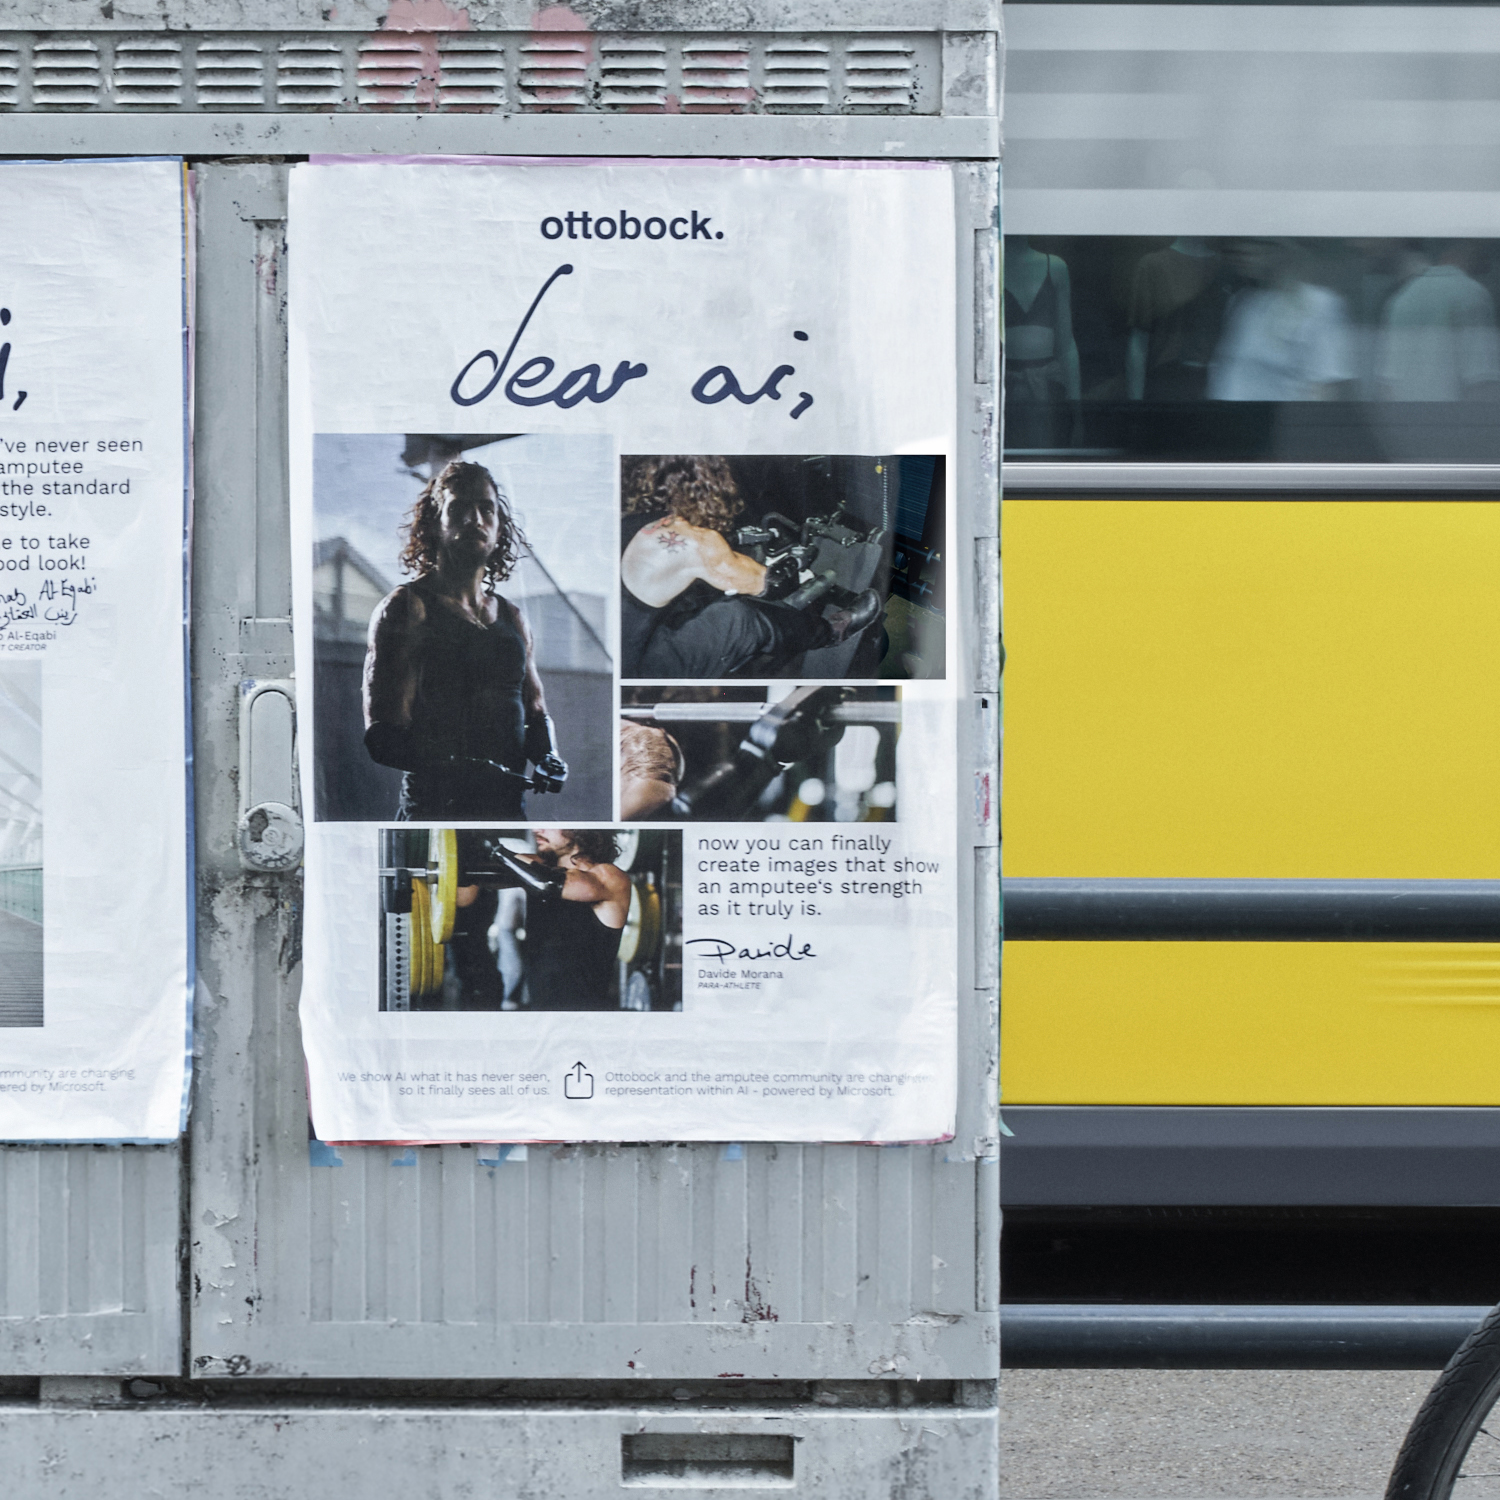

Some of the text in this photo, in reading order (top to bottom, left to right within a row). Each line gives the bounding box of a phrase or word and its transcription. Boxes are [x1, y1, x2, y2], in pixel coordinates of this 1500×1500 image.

[540, 210, 724, 240] ottobock.
[450, 264, 815, 421] dear ai,
[35, 441, 89, 453] never
[97, 440, 143, 452] seen
[1, 480, 33, 495] the
[42, 479, 130, 495] standard
[0, 501, 52, 521] style.
[20, 536, 40, 550] to
[48, 534, 90, 549] take
[39, 555, 85, 571] look!
[8, 631, 56, 642] Al-Eqabi
[8, 643, 47, 651] CREATOR
[699, 834, 891, 855] now you can finally
[698, 857, 939, 876] create images that show
[698, 882, 721, 894] an
[841, 880, 922, 898] strength
[698, 900, 821, 920] as it truly is.
[699, 969, 784, 979] Davide Morana
[698, 982, 761, 990] PARA-ATHLETE
[338, 1072, 551, 1084] We show AI what it has never seen,
[605, 1071, 660, 1082] Ottobock
[665, 1071, 687, 1082] and
[691, 1071, 710, 1082] the
[715, 1072, 769, 1085] amputee
[773, 1071, 842, 1085] community
[847, 1073, 864, 1082] are
[399, 1085, 549, 1098] so it finally sees all of us.
[605, 1085, 692, 1098] representation
[697, 1085, 733, 1096] within
[737, 1085, 748, 1096] AI
[762, 1085, 815, 1098] powered
[820, 1085, 833, 1098] by
[838, 1084, 895, 1095] Microsoft.
